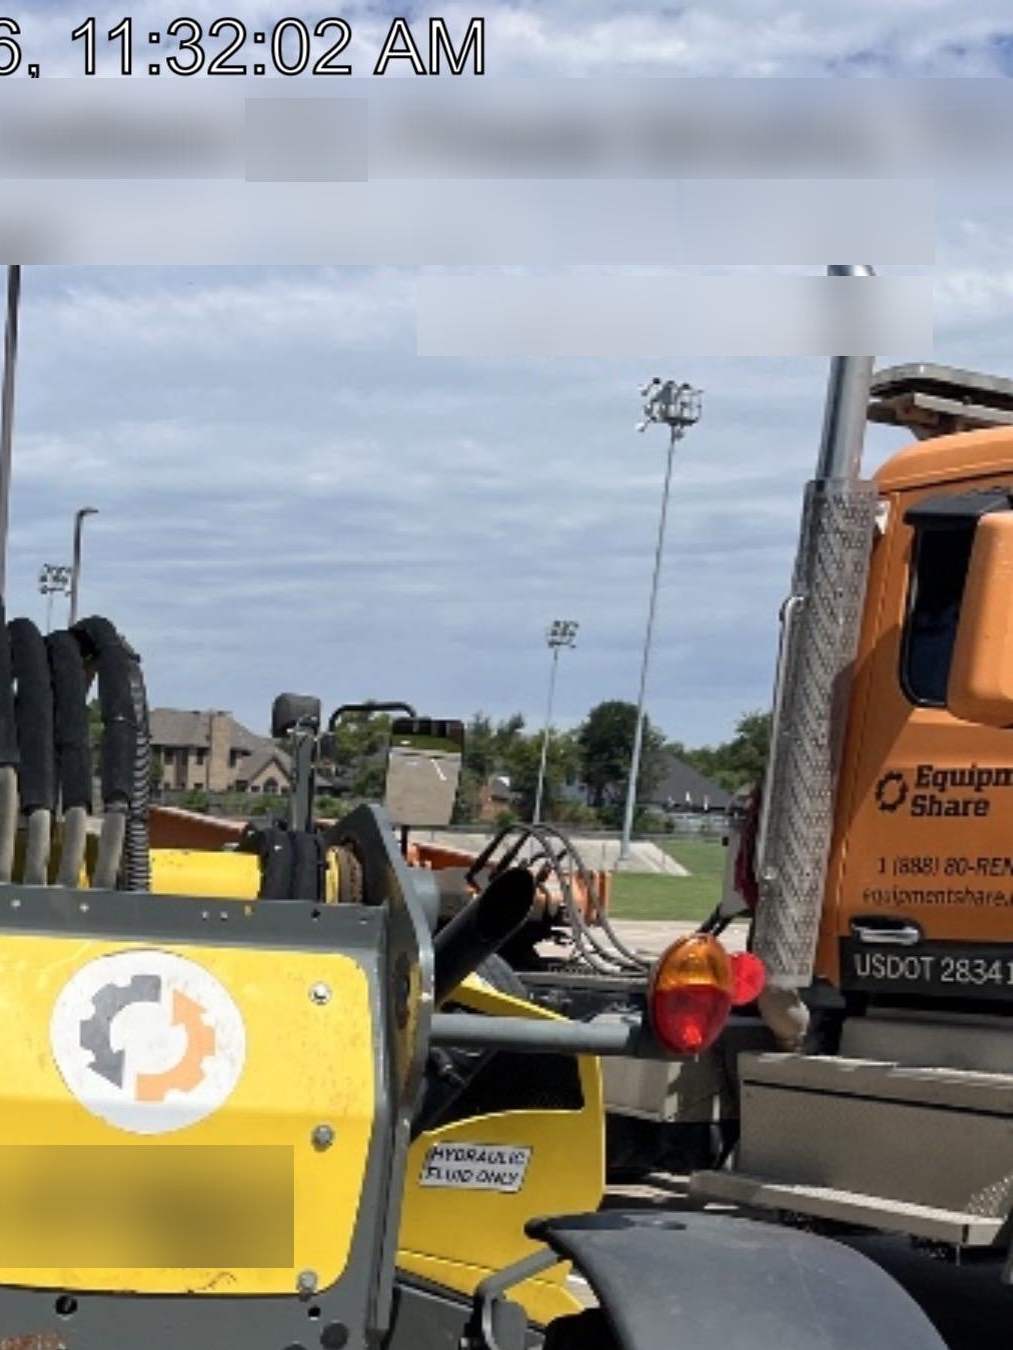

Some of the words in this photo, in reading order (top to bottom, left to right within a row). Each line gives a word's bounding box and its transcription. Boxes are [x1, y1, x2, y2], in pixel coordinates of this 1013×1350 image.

[910, 794, 990, 817] Share
[878, 857, 886, 874] 1
[893, 856, 939, 876] (888)
[854, 953, 935, 980] USDOT
[431, 1146, 525, 1165] HYDRAULIC
[425, 1167, 473, 1183] FLUID
[476, 1169, 519, 1186] ONLY
